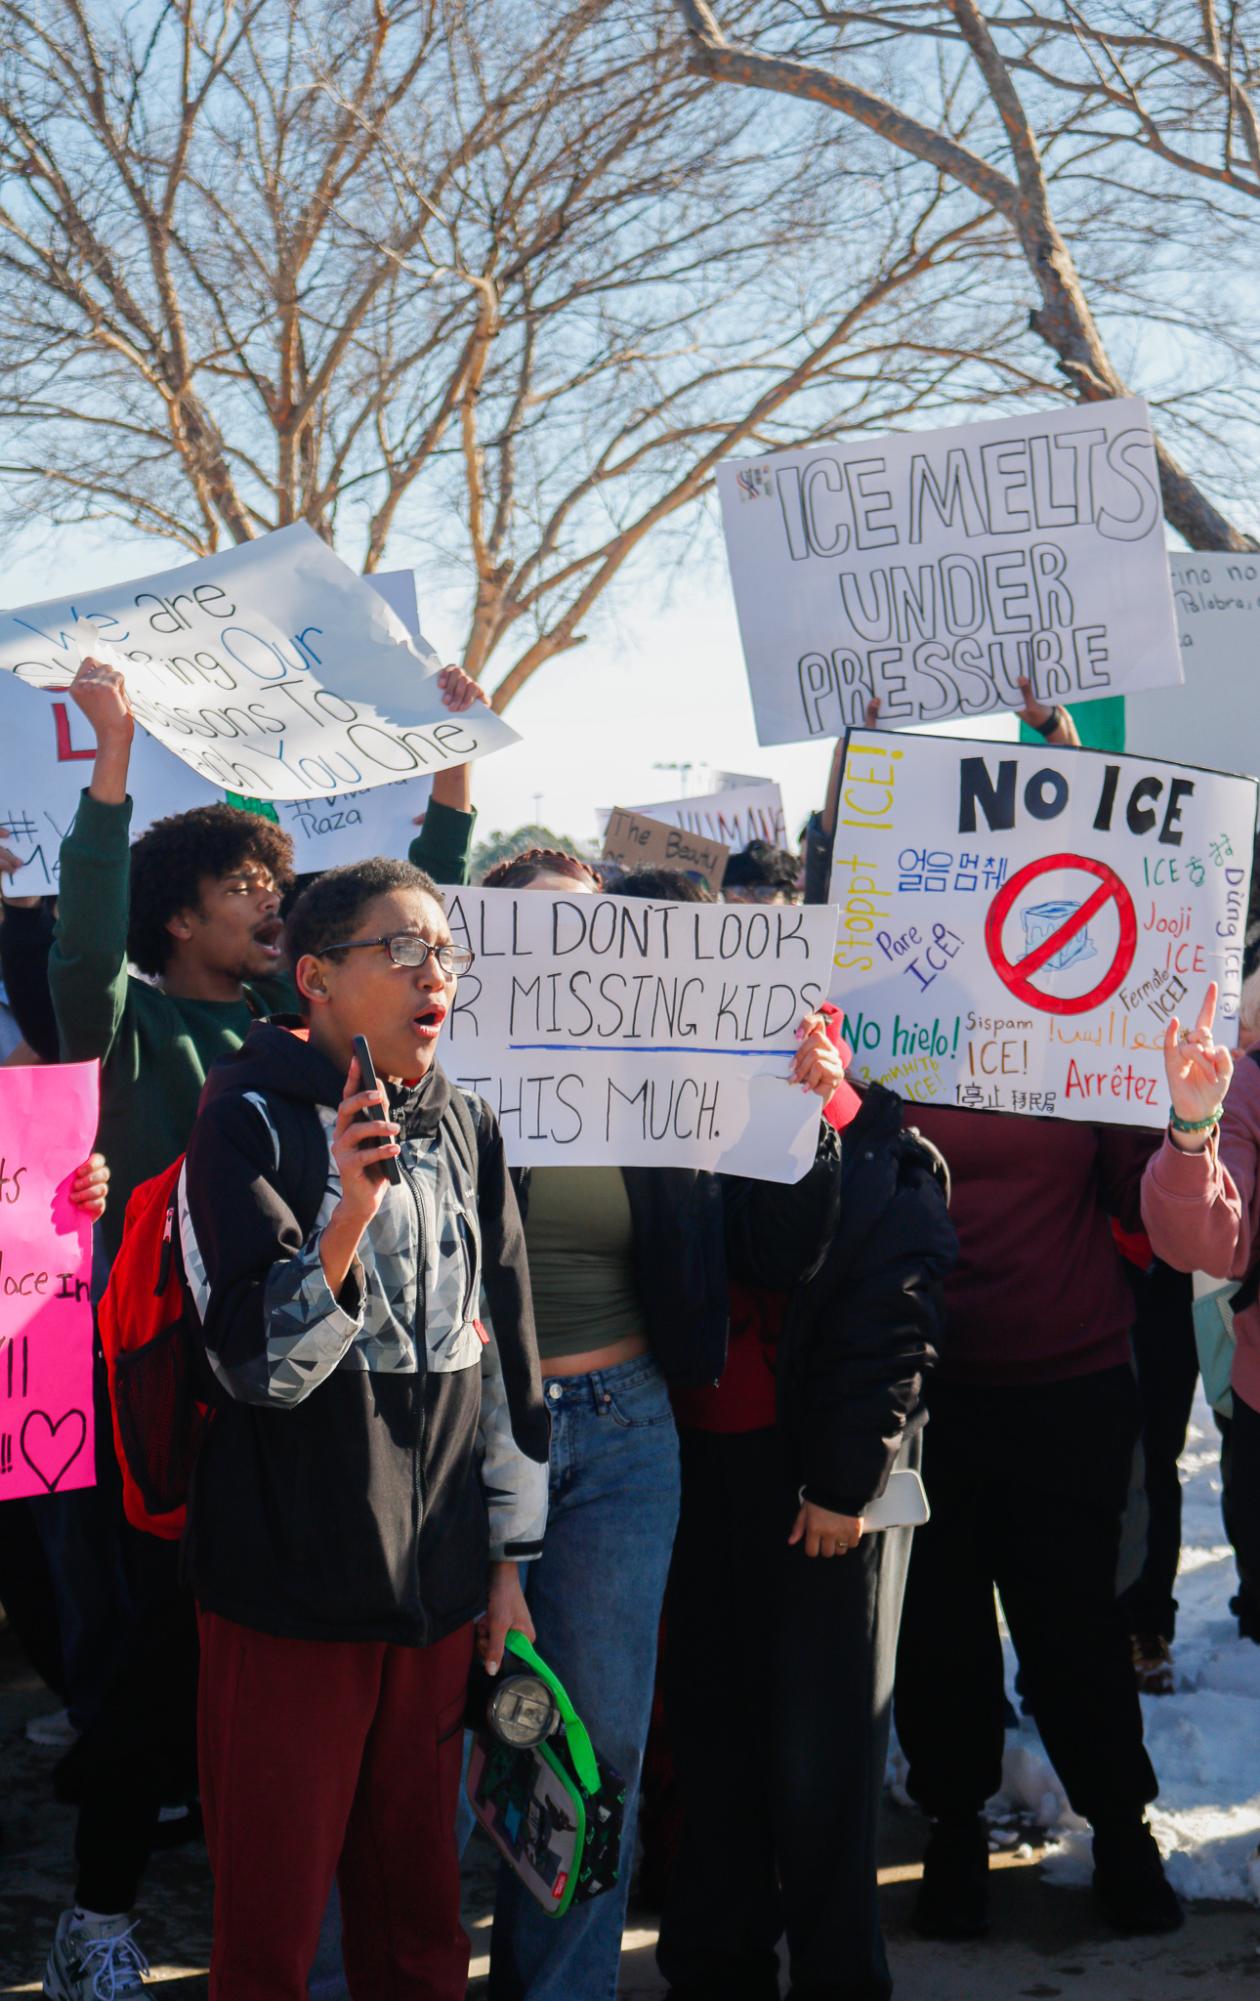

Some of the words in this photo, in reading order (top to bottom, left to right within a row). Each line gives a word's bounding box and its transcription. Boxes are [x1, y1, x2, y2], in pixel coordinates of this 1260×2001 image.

[776, 458, 899, 561] ICE
[909, 428, 1161, 544] MELTS
[839, 542, 1075, 643] UNDER
[1226, 566, 1257, 581] no
[134, 583, 236, 634] are
[220, 627, 323, 680] Our
[798, 624, 1112, 735] PRESSURE
[131, 690, 286, 738] ssons
[260, 680, 358, 727] To
[242, 740, 362, 790] You
[346, 723, 478, 771] One
[842, 744, 904, 829] ICE!
[958, 756, 1069, 833] NO
[1093, 765, 1195, 846] ICE
[292, 809, 363, 839] Raza
[611, 811, 651, 846] The
[664, 831, 719, 876] Beauty
[897, 848, 954, 893] 얼음
[1143, 856, 1181, 888] ICE
[441, 892, 534, 957] ALL
[552, 900, 680, 959] DON'T
[694, 912, 811, 961] LOOK
[834, 854, 893, 971] Stoppt
[1143, 900, 1193, 939] Jooji
[875, 926, 923, 962] Pare
[1165, 941, 1208, 975] ICE
[1223, 946, 1243, 980] ICE
[510, 970, 705, 1039] MISSING
[715, 982, 823, 1042] KIDS
[1118, 967, 1170, 1013] Fermate
[842, 1012, 882, 1054] No
[892, 1014, 961, 1060] hielo!
[967, 1039, 1028, 1077] ICE!
[904, 1073, 947, 1102] ICE!
[955, 1081, 1006, 1110] 停止
[1064, 1057, 1159, 1106] Arrêtez
[605, 1077, 720, 1143] MUCH.
[54, 1272, 91, 1303] In
